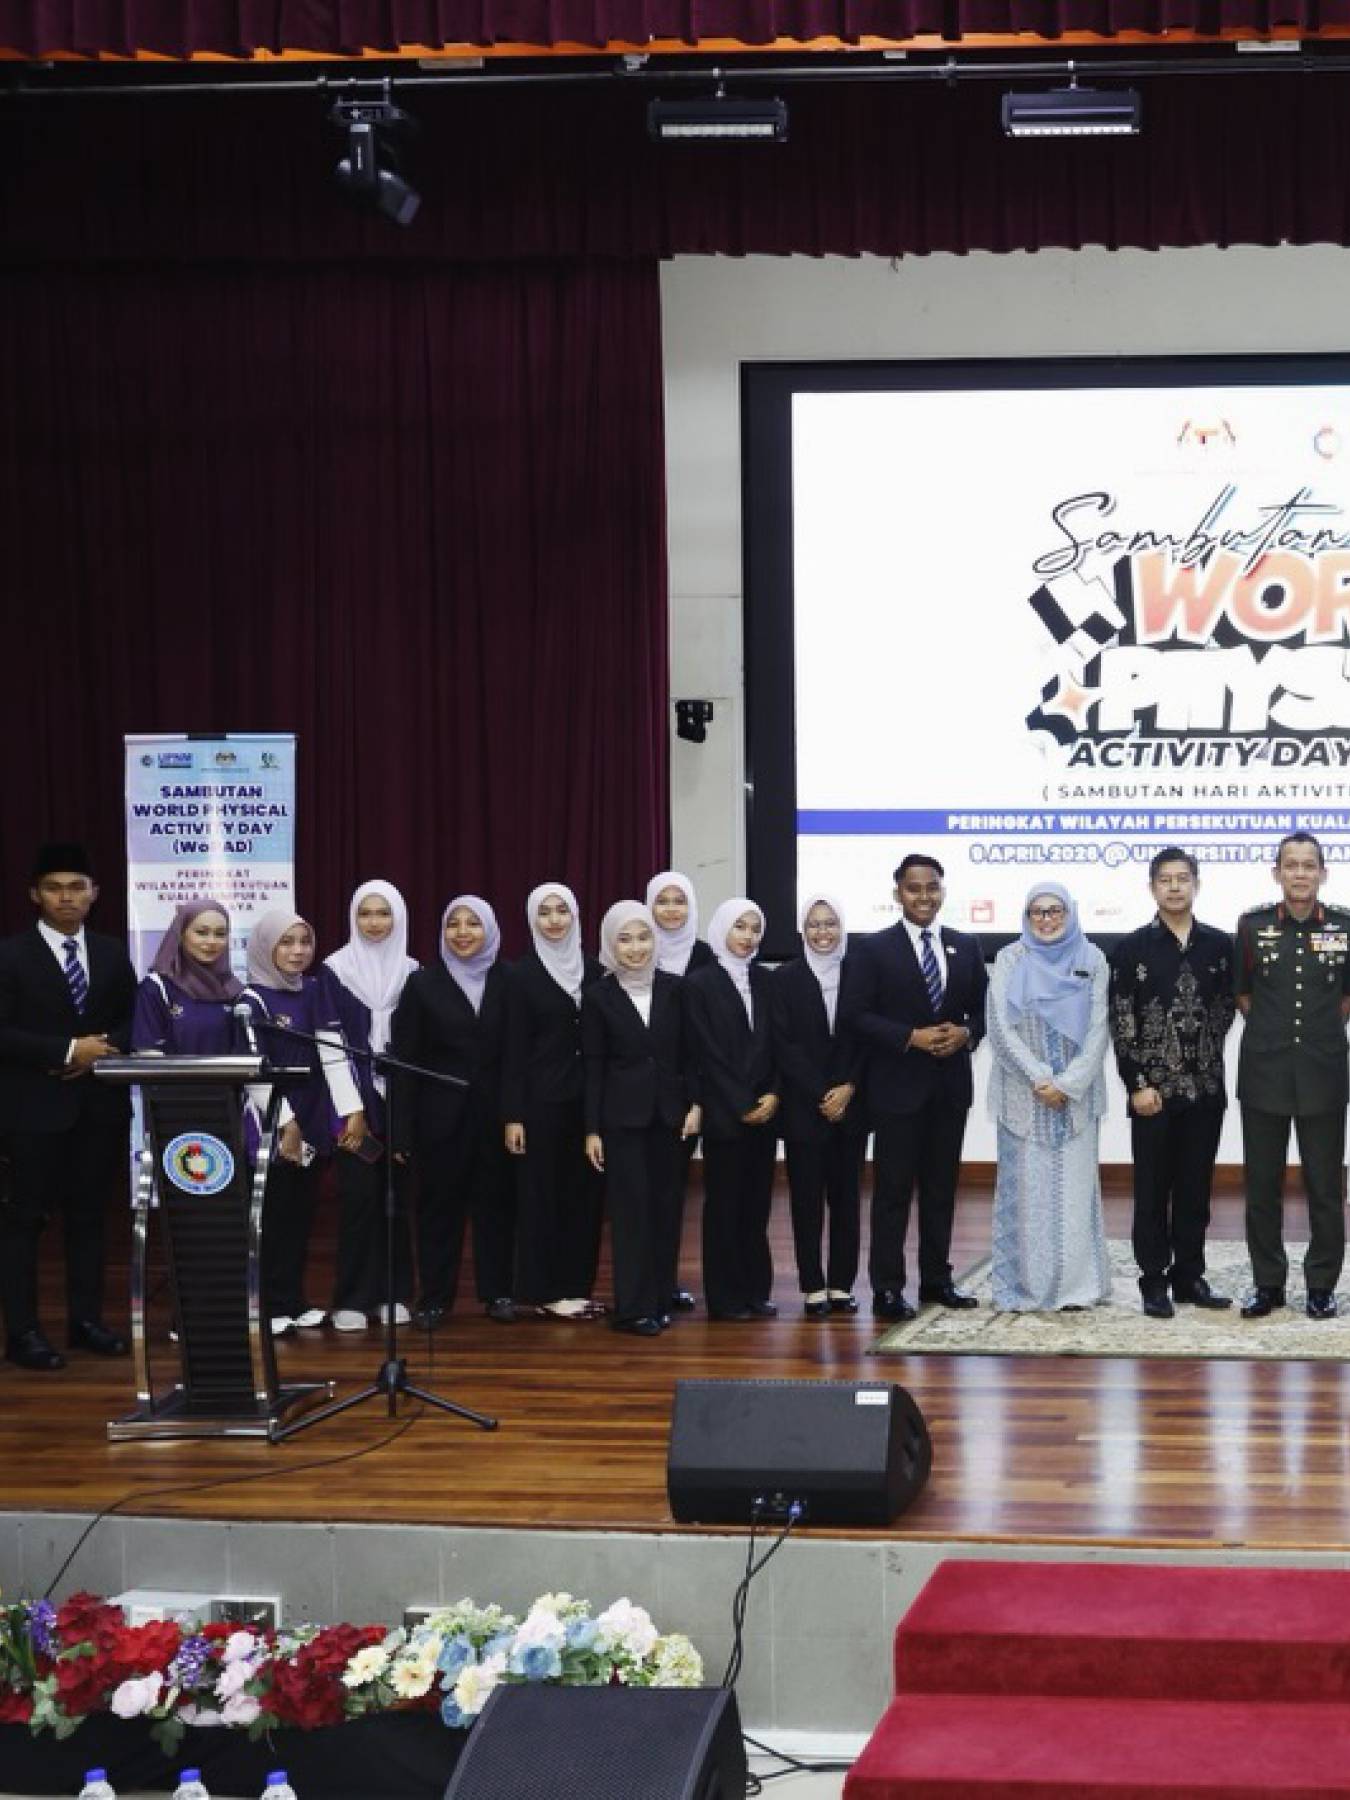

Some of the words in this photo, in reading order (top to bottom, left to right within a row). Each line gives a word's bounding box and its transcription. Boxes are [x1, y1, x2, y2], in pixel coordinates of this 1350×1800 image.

[1032, 484, 1348, 578] Sambutan
[1067, 741, 1260, 767] ACTIVITY
[1057, 785, 1183, 798] SAMBUTAN
[1194, 785, 1249, 798] HARI
[133, 803, 199, 817] WORLD
[150, 823, 235, 835] ACTIVIY
[238, 823, 274, 835] DAY
[948, 814, 1055, 830] PERINGKAT
[1059, 814, 1150, 830] WILAYAH
[1154, 814, 1292, 830] PERSEKUTUAN
[173, 839, 253, 854] (WoAD)
[988, 843, 1047, 862] APRIL
[1103, 841, 1130, 867] @
